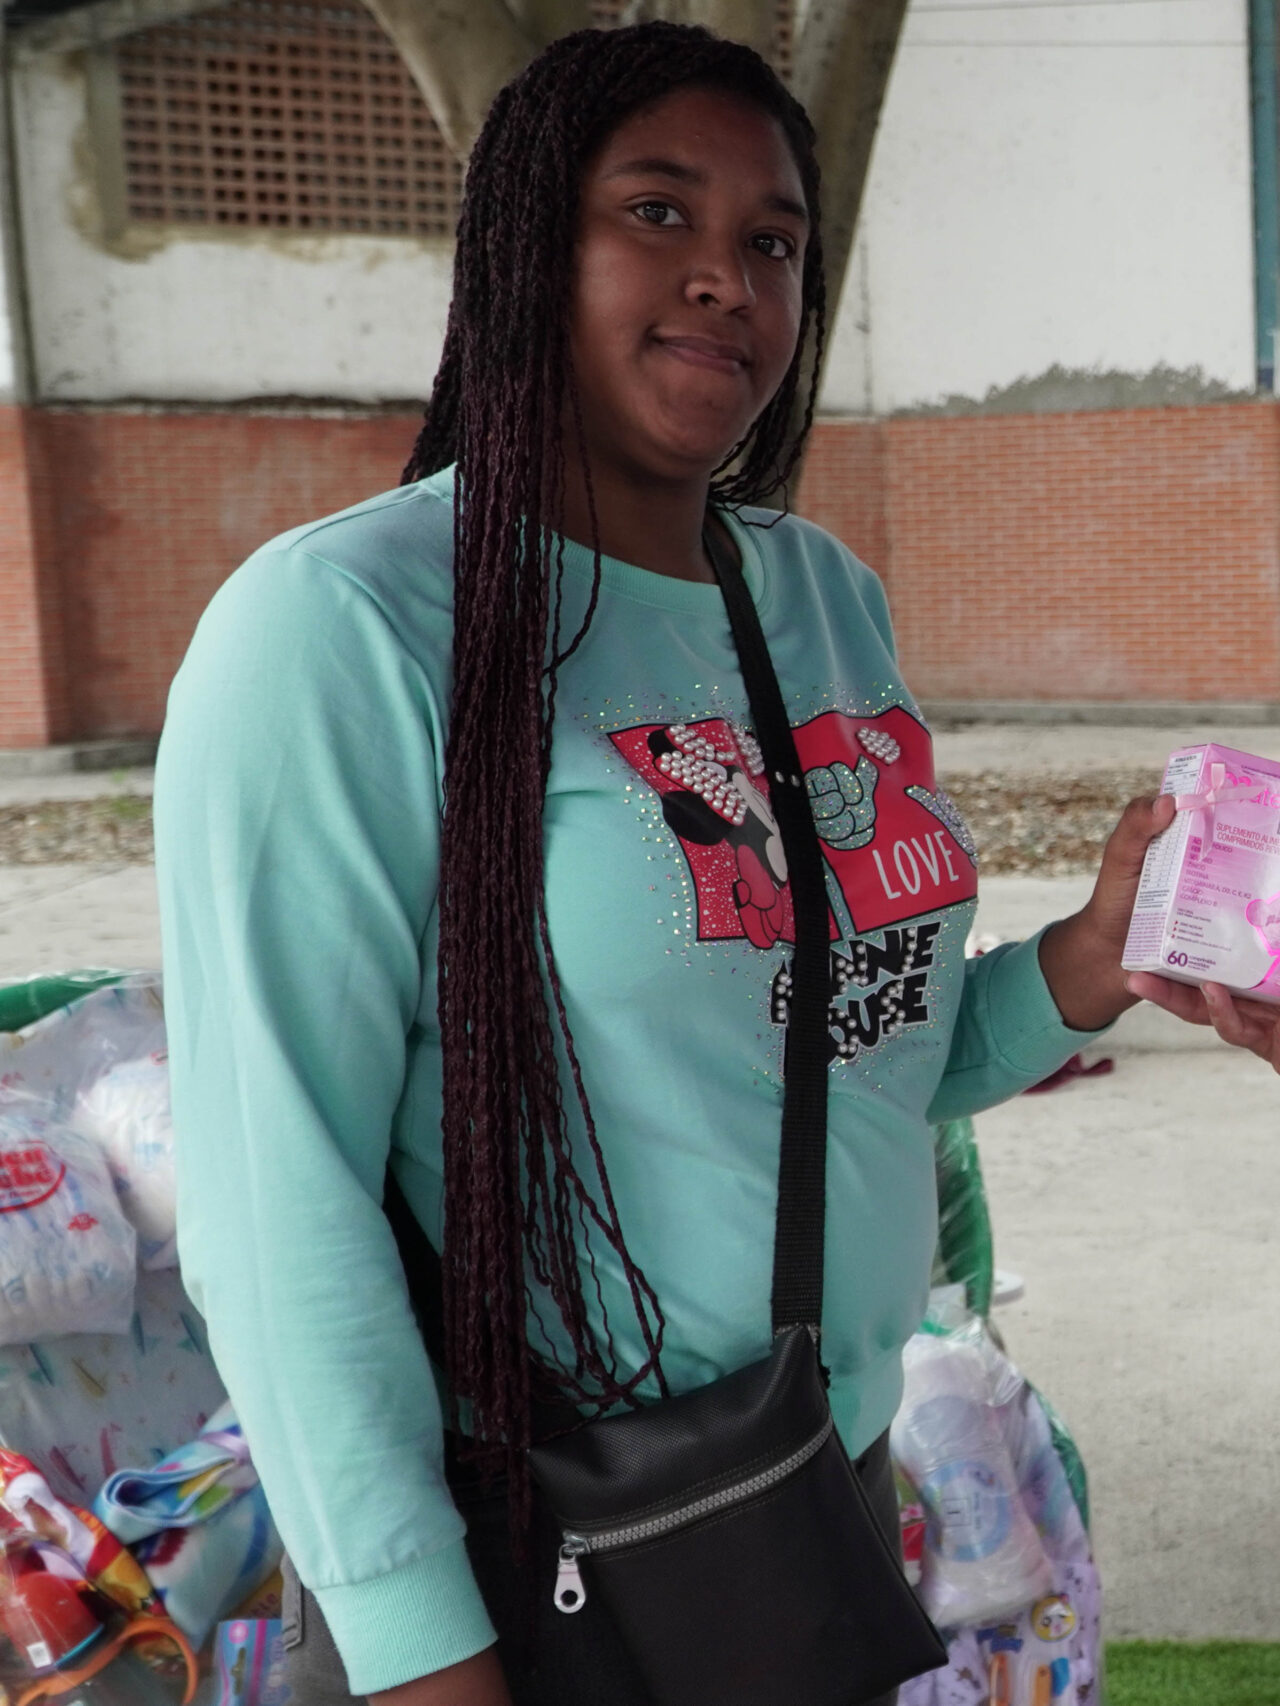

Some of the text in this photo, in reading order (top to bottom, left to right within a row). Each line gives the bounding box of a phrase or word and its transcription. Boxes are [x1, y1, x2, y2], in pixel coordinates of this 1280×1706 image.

[1215, 822, 1261, 841] SUPLEMENTO
[1216, 832, 1264, 851] COMPRIMIDOS
[872, 830, 960, 899] LOVE
[1167, 950, 1188, 967] 60
